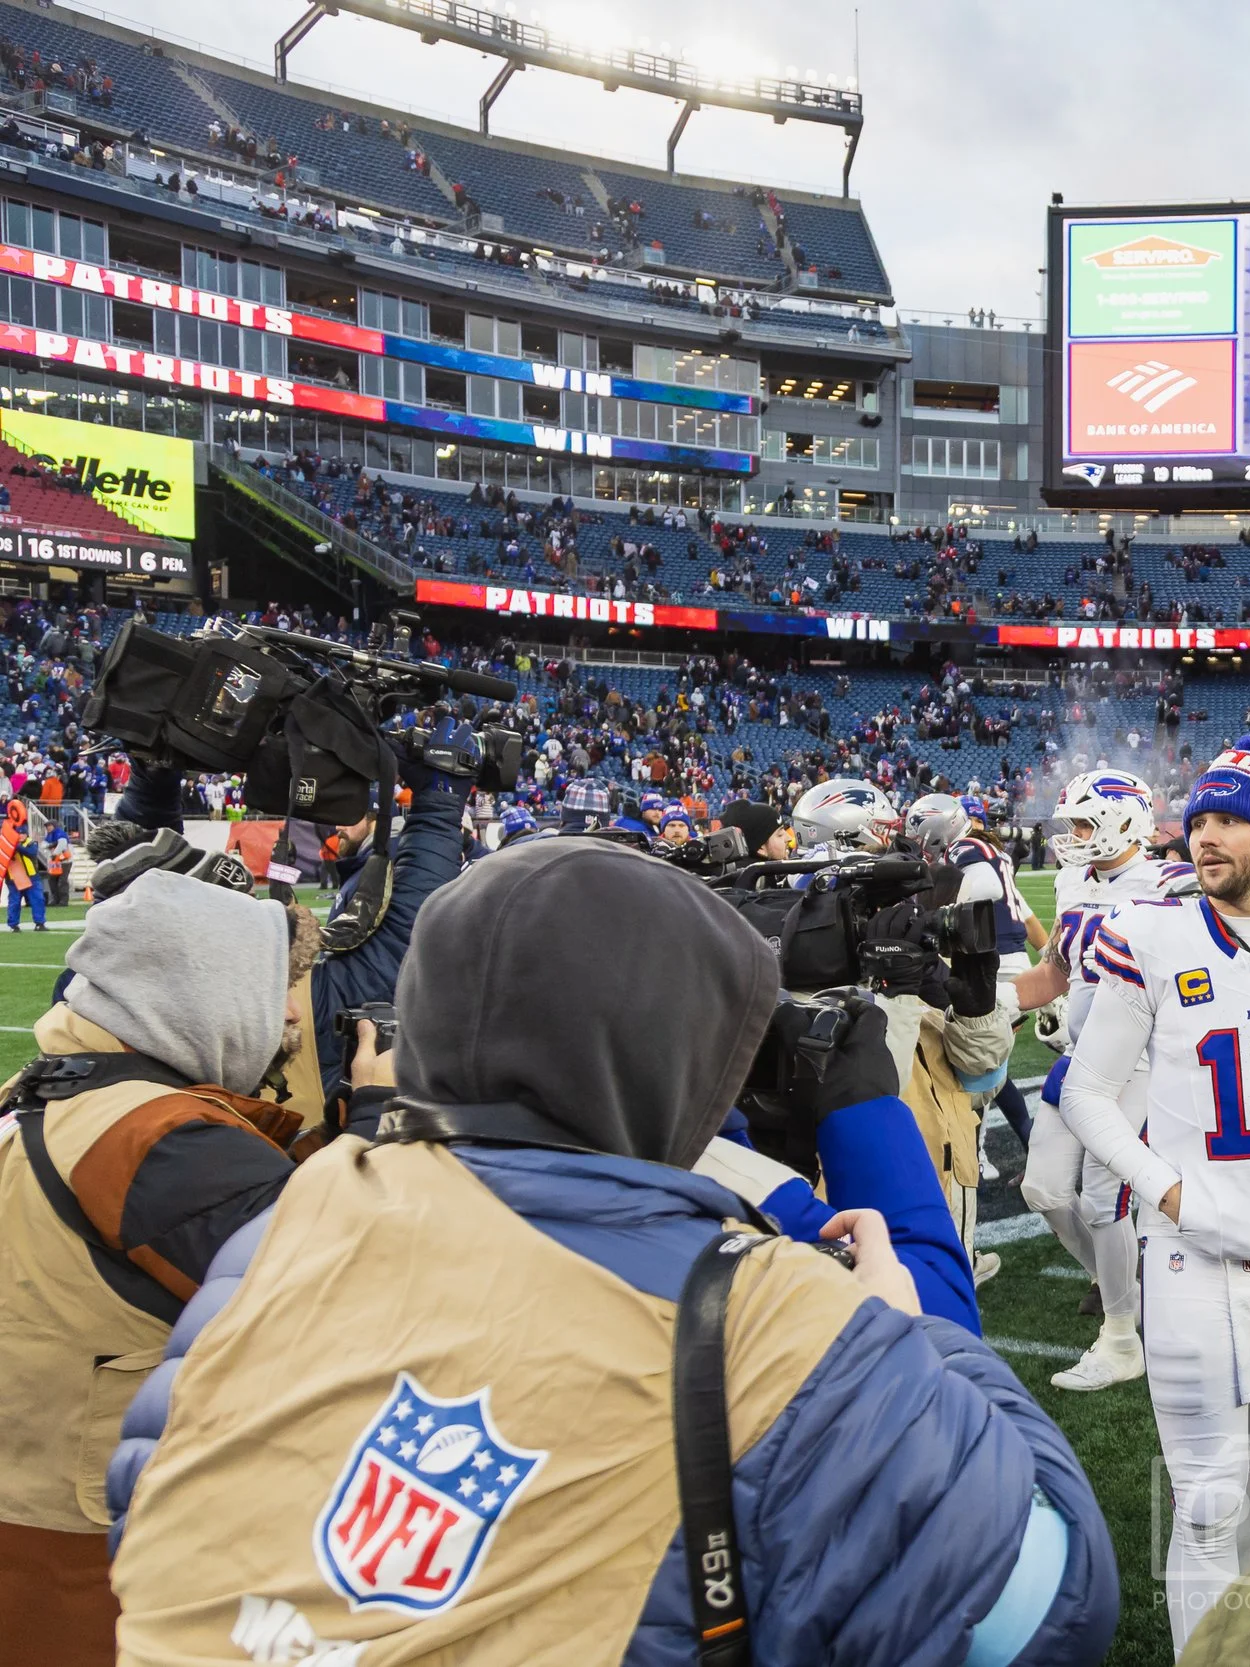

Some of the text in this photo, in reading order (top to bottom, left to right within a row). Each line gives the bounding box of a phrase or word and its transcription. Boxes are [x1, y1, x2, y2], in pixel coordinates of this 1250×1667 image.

[1112, 249, 1194, 264] SERVPRO
[33, 252, 293, 336] PATRIOTS
[35, 331, 294, 405] PATRIOTS
[532, 363, 612, 398] WIN
[532, 426, 612, 459] WIN
[1087, 423, 1217, 436] BANK OF AMERICA
[28, 538, 123, 565] 16 1ST DOWNS
[140, 551, 157, 571] 6
[485, 587, 655, 626] PATRIOTS
[826, 617, 890, 642] WIN
[1058, 628, 1216, 649] PATRIOTS
[430, 748, 453, 756] Canon
[1178, 969, 1209, 998] C
[336, 1460, 460, 1592] NFL
